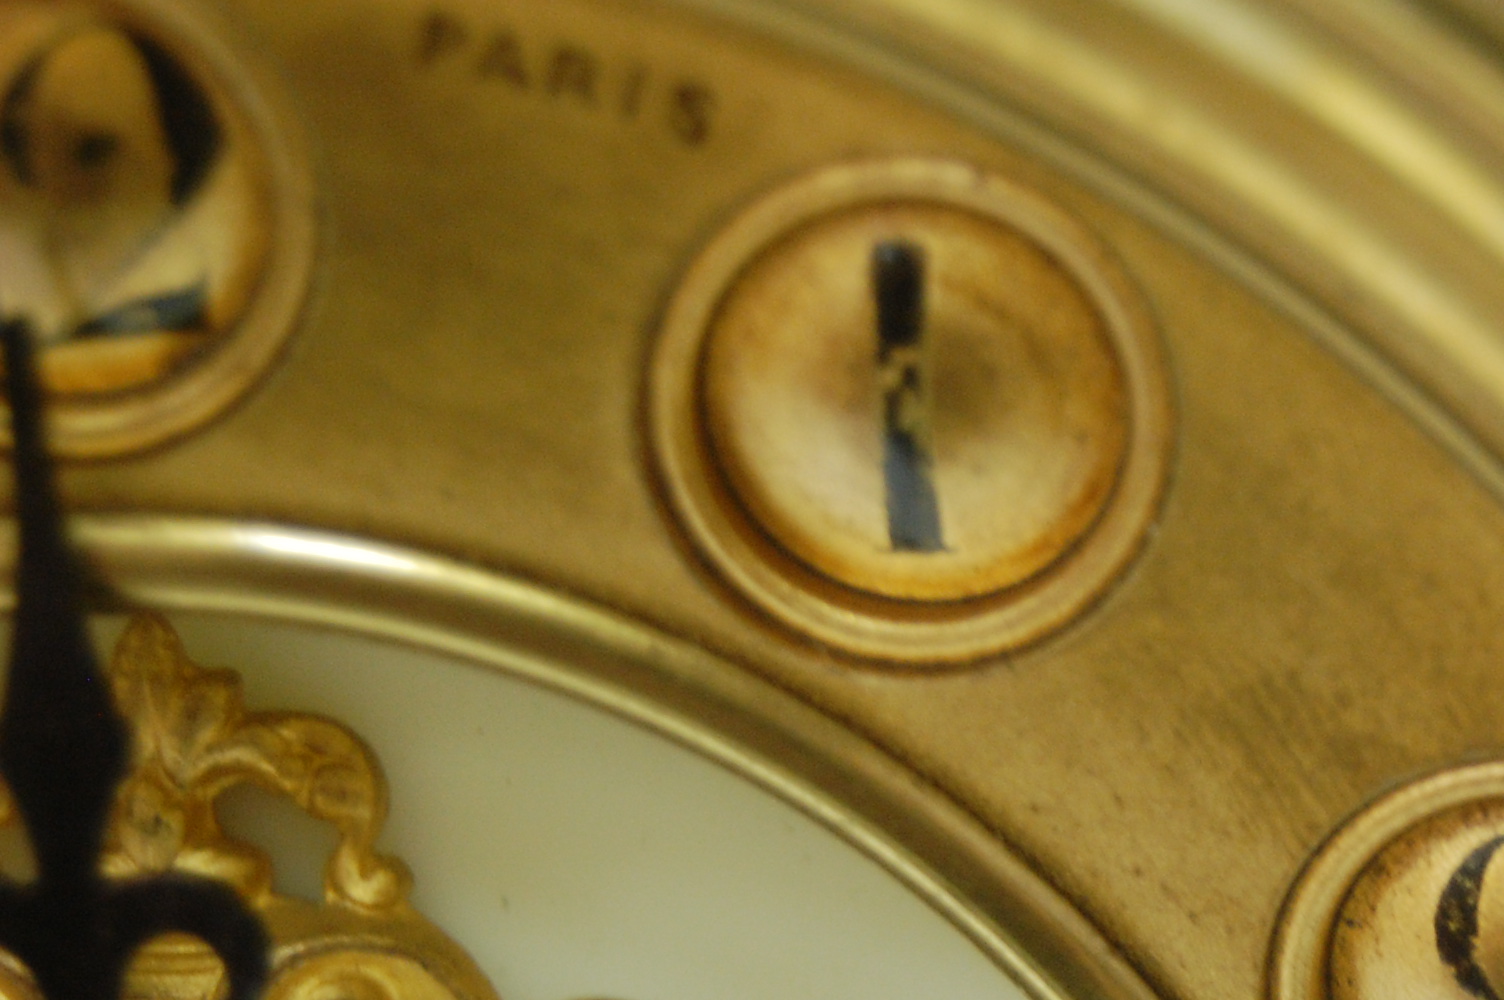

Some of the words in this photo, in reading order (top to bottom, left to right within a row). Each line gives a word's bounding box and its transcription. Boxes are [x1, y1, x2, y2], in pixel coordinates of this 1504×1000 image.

[0, 18, 224, 340] 2
[417, 10, 713, 148] PARIS
[870, 238, 955, 554] 1
